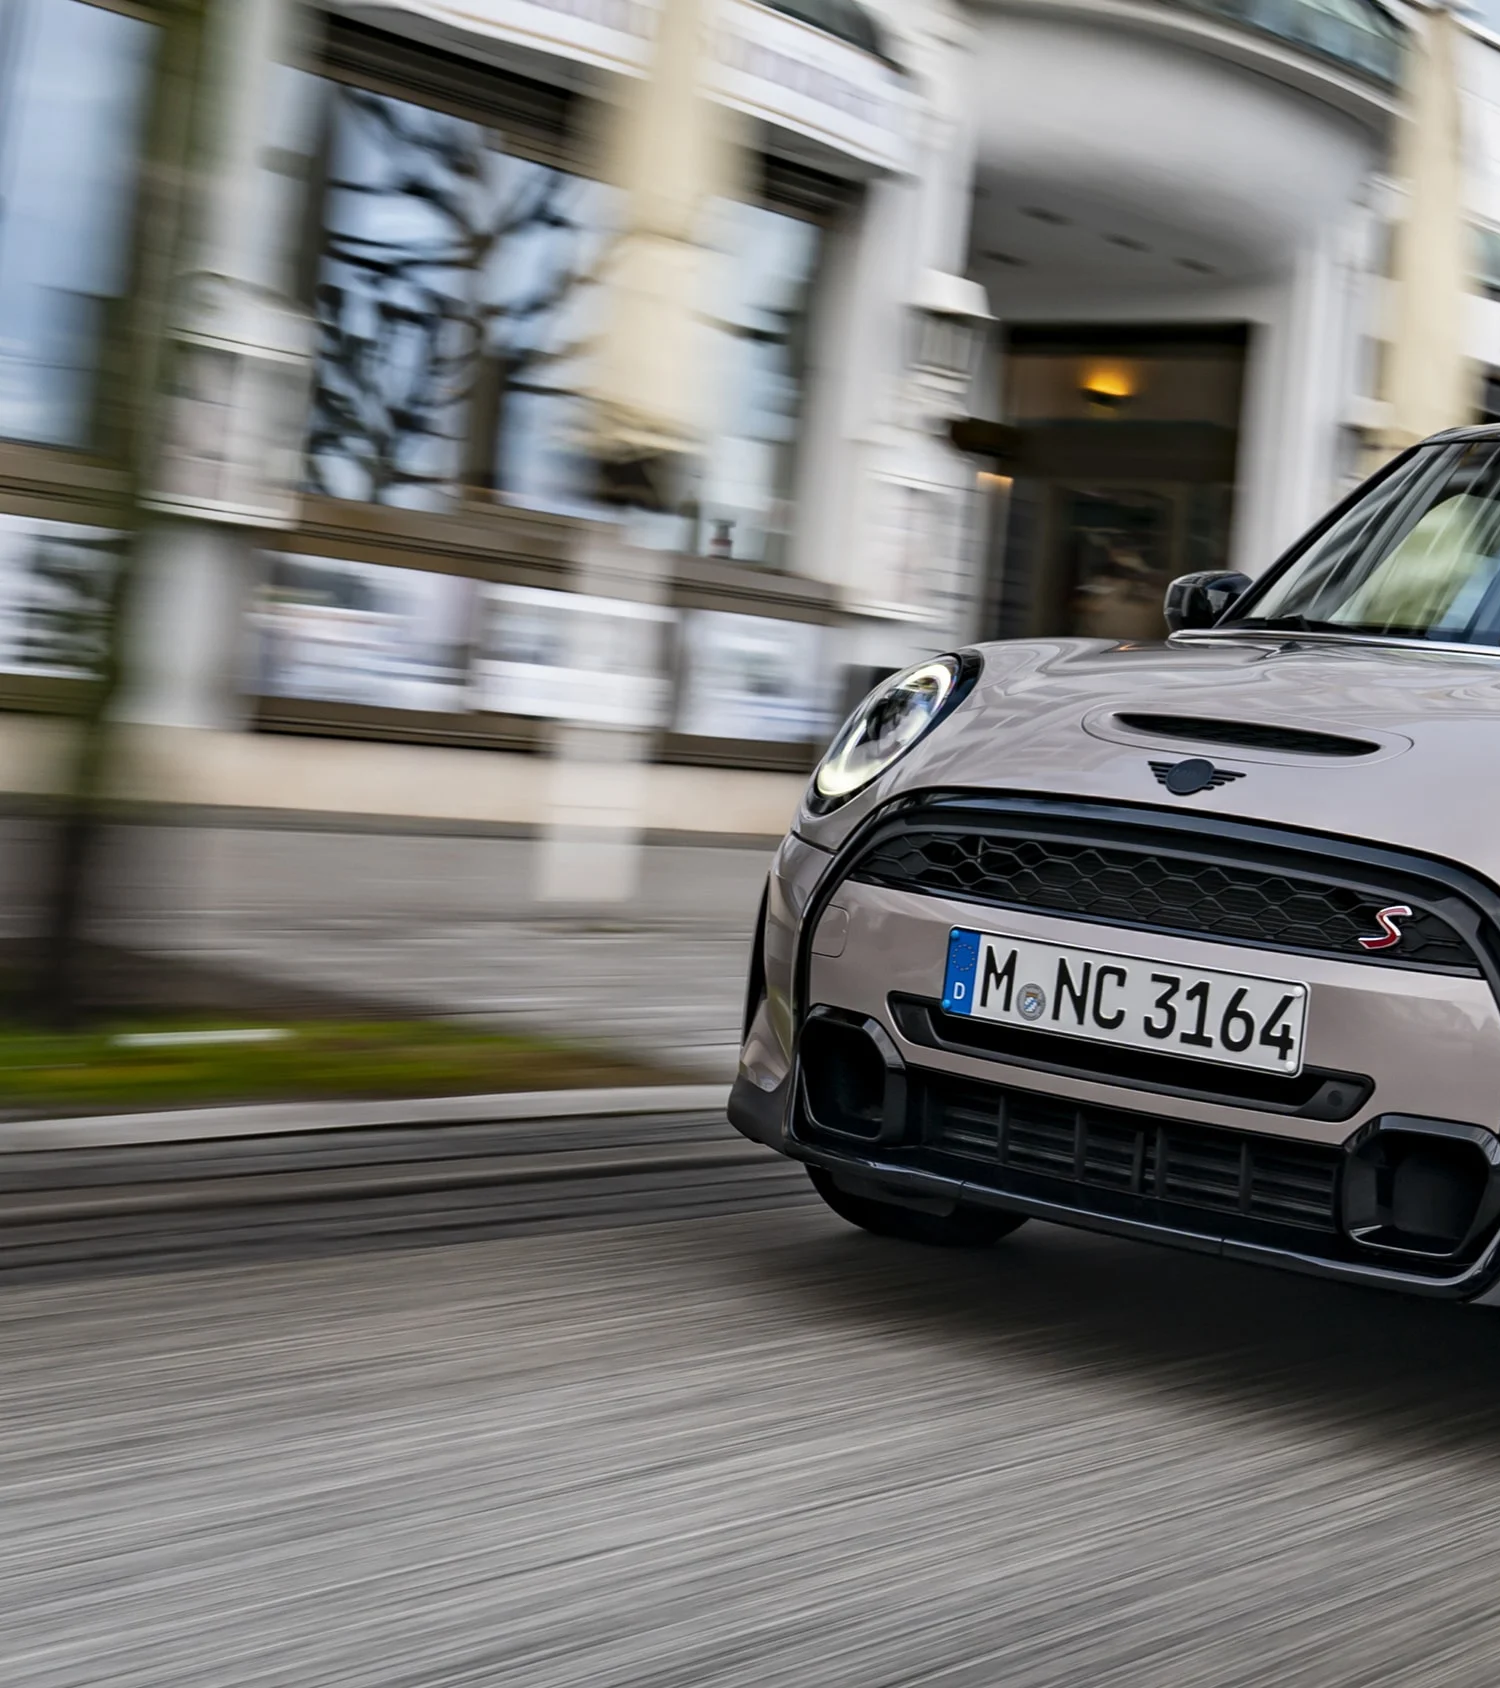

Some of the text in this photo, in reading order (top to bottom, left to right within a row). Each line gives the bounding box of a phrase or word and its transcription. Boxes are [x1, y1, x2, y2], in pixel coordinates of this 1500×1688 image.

[1358, 905, 1413, 950] S
[953, 982, 966, 1000] D
[980, 945, 1295, 1061] M NC 3164
